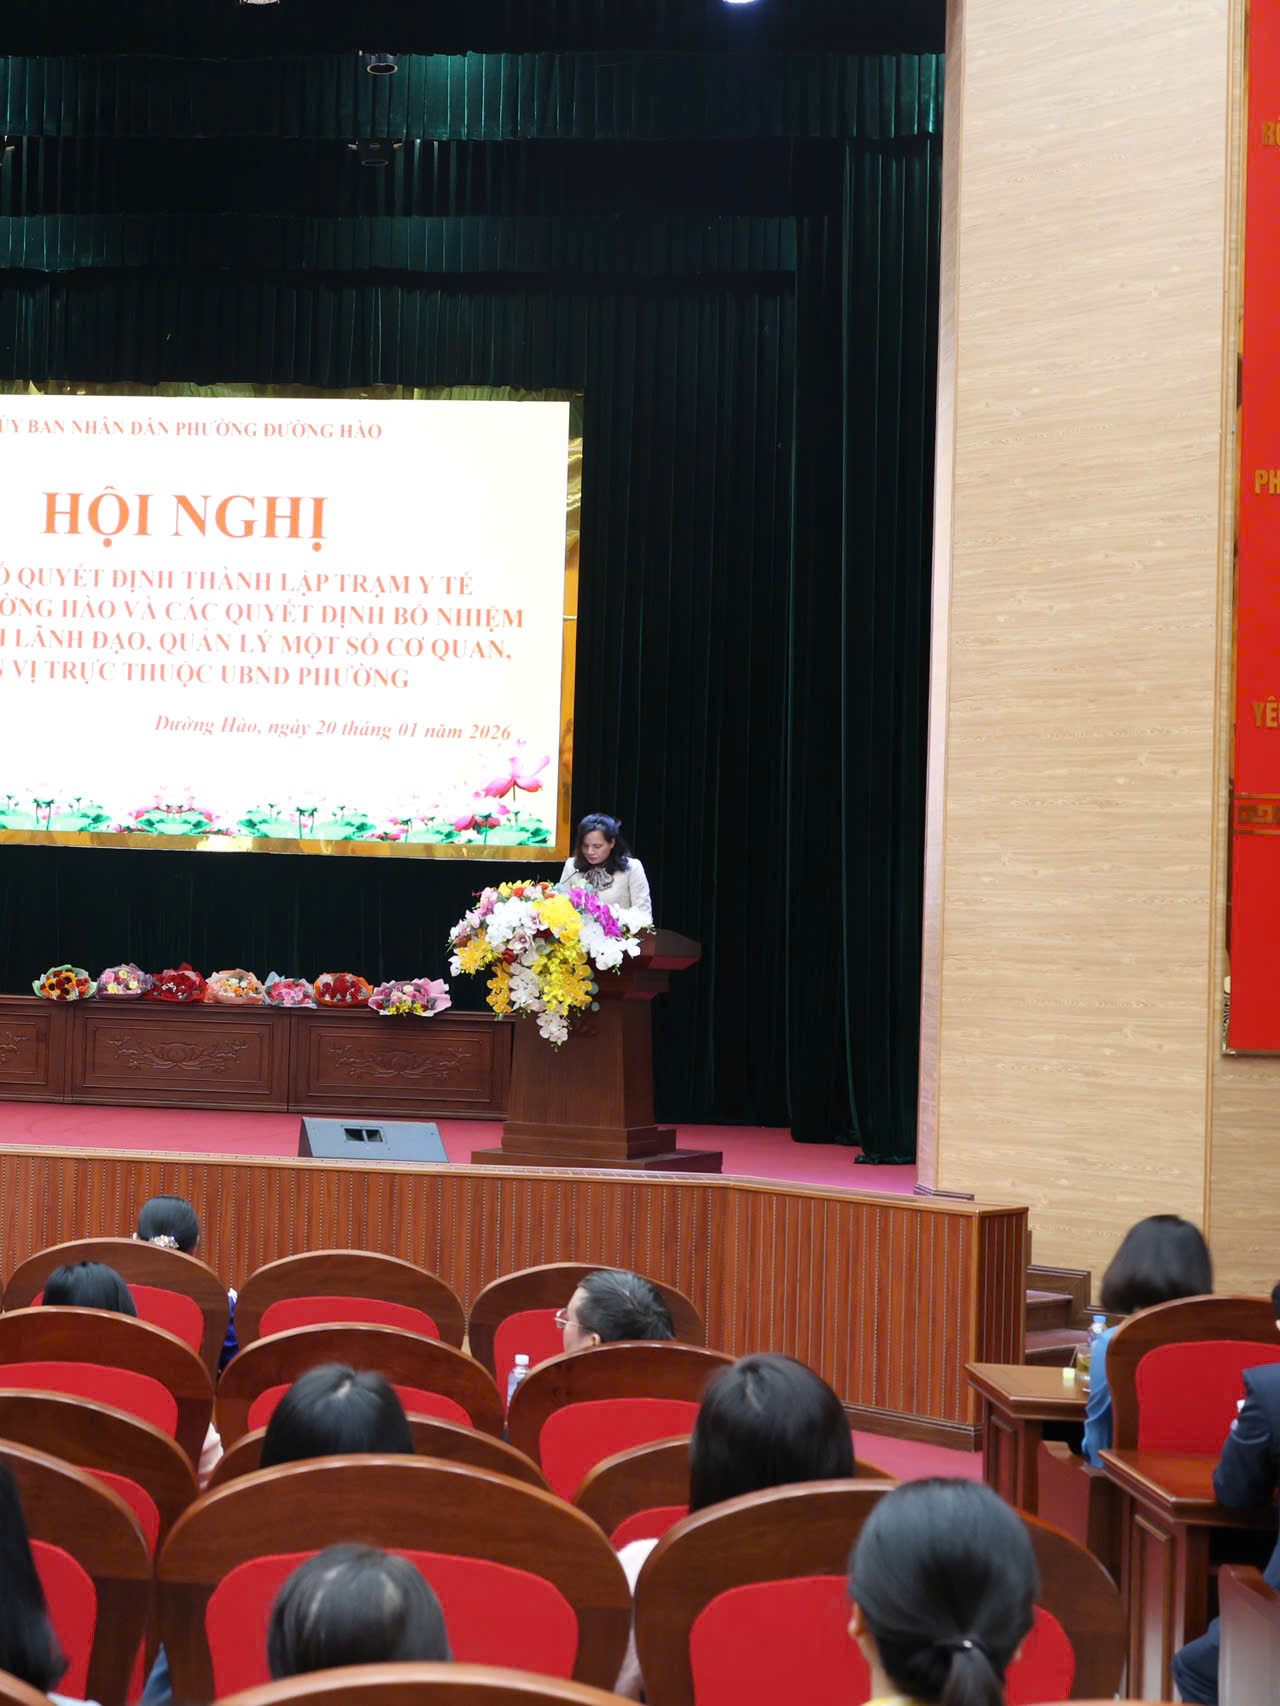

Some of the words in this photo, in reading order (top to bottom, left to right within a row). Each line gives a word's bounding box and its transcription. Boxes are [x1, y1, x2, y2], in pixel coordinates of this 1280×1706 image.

[29, 420, 64, 434] BAN
[72, 416, 124, 435] NHÂN
[131, 417, 168, 435] DÂN
[176, 419, 256, 436] PHƯỜNG
[340, 421, 382, 438] HÀO
[40, 486, 152, 548] HỘI
[171, 495, 328, 552] NGHỊ
[183, 566, 271, 591] THÀNH
[336, 574, 409, 598] TRẠM
[419, 576, 433, 594] Y
[63, 595, 116, 618] HÀO
[124, 596, 156, 619] VÀ
[165, 597, 217, 620] CÁC
[16, 625, 82, 648] LÃNH
[240, 630, 271, 653] LÝ
[386, 637, 424, 656] CƠ
[432, 640, 511, 661] QUAN,
[13, 660, 36, 683] VỊ
[45, 659, 115, 684] TRỰC
[222, 665, 289, 685] UBND
[299, 663, 408, 688] PHƯỜNG
[1252, 696, 1280, 728] YÊ
[221, 717, 261, 734] Hào,
[268, 720, 310, 738] ngày
[316, 720, 336, 735] 20
[342, 720, 392, 740] tháng
[399, 723, 417, 737] 01
[424, 724, 462, 738] năm
[469, 724, 512, 740] 2026
